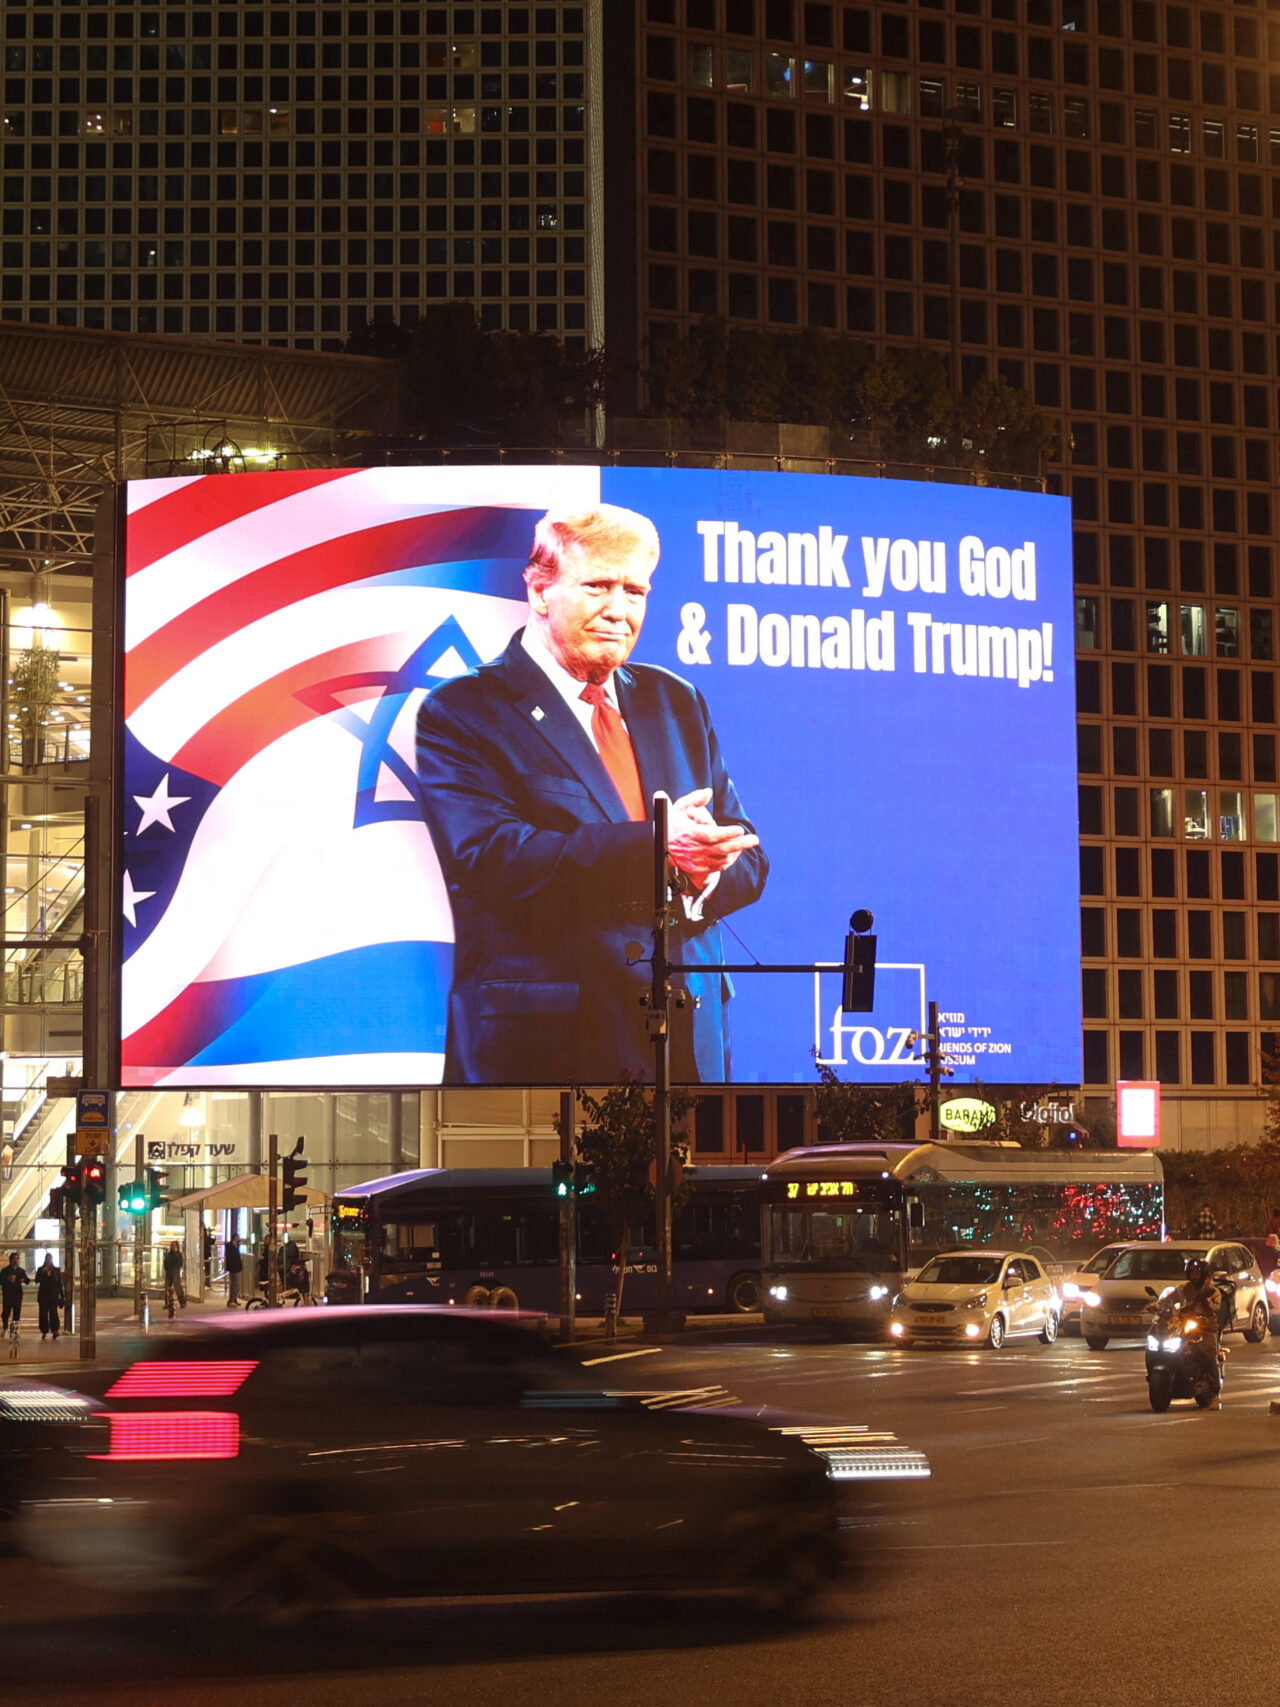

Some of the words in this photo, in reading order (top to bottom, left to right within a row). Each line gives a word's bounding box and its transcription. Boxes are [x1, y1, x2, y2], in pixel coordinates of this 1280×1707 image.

[696, 520, 851, 588] Thank
[861, 536, 947, 598] you
[958, 535, 1037, 601] God
[676, 601, 712, 666] &
[727, 603, 895, 672] Donald
[907, 612, 1054, 689] Trump!
[938, 1012, 965, 1024] מוזיא
[939, 1026, 965, 1038] ישרא
[938, 1042, 973, 1053] RIENDS
[973, 1042, 988, 1054] OF
[988, 1043, 1013, 1054] ZION
[940, 1054, 976, 1065] USEUM
[167, 1142, 202, 1158] קפלן
[205, 1144, 236, 1156] שער
